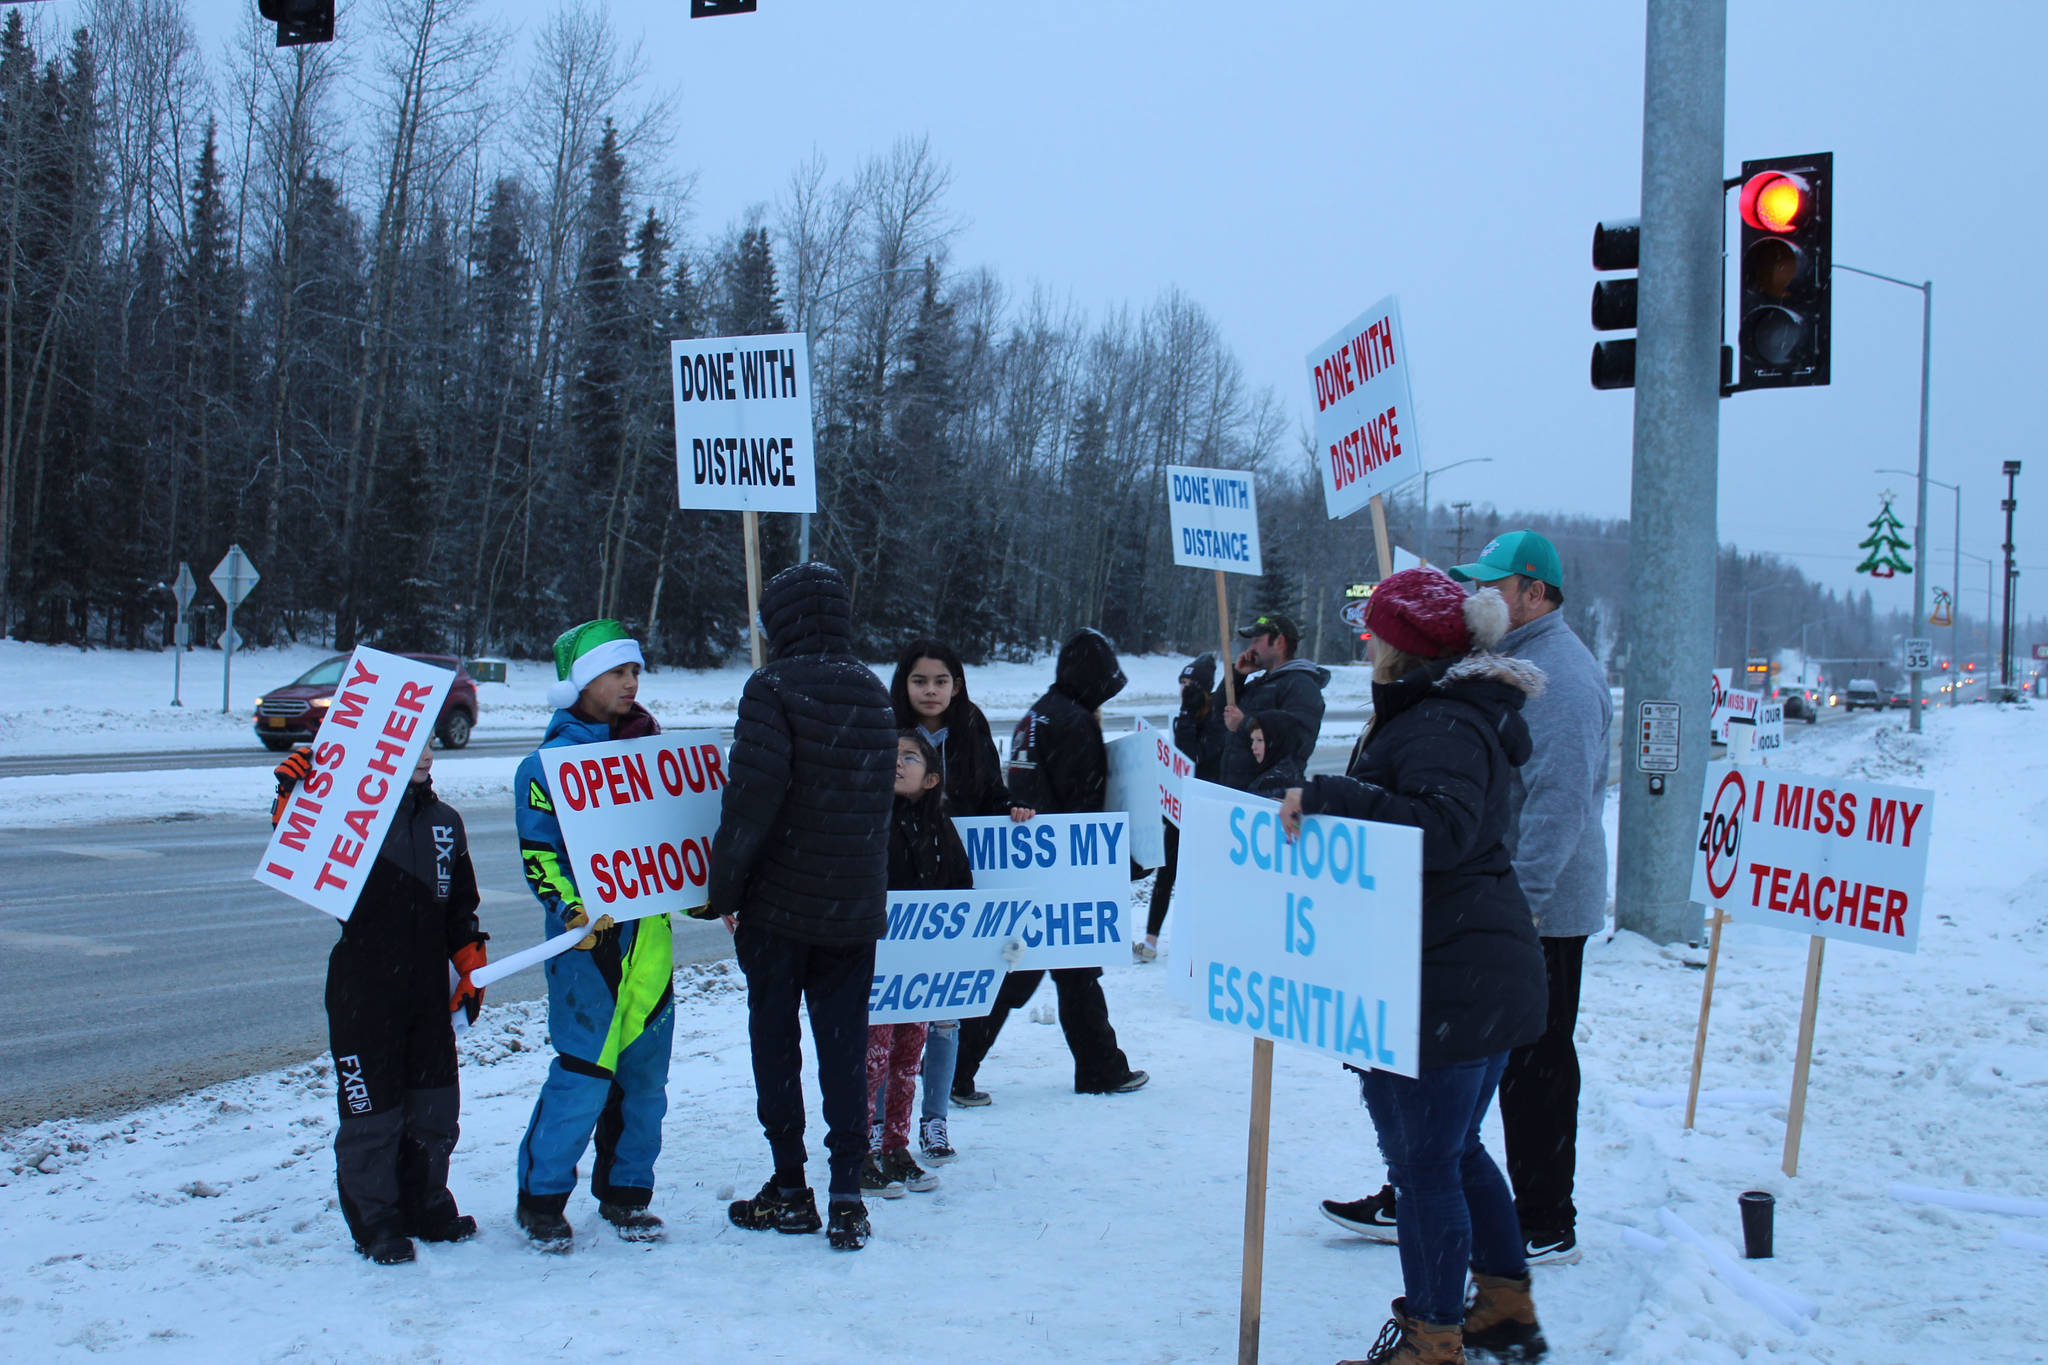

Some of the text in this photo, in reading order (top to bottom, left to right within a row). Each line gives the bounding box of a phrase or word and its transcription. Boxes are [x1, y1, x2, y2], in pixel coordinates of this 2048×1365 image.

[680, 349, 797, 402] DONE WITH
[1314, 316, 1395, 412] DONE WITH
[693, 437, 796, 487] DISTANCE
[1330, 406, 1402, 491] DISTANCE
[1173, 474, 1249, 510] DONE WITH
[1183, 527, 1250, 562] DISTANCE
[1907, 655, 1929, 668] 35
[1765, 707, 1781, 723] OUR
[266, 659, 380, 881] I MISS MY
[314, 681, 434, 891] TEACHER
[559, 744, 729, 811] OPEN OUR
[1752, 780, 1924, 848] I MISS MY
[432, 825, 454, 879] FXR
[966, 822, 1124, 871] MISS MY
[1229, 806, 1376, 891] SCHOOL
[881, 900, 1032, 941] MISS MY
[1285, 892, 1316, 957] IS
[1750, 863, 1909, 937] TEACHER
[1208, 961, 1396, 1067] ESSENTIAL
[339, 1054, 369, 1101] FXR
